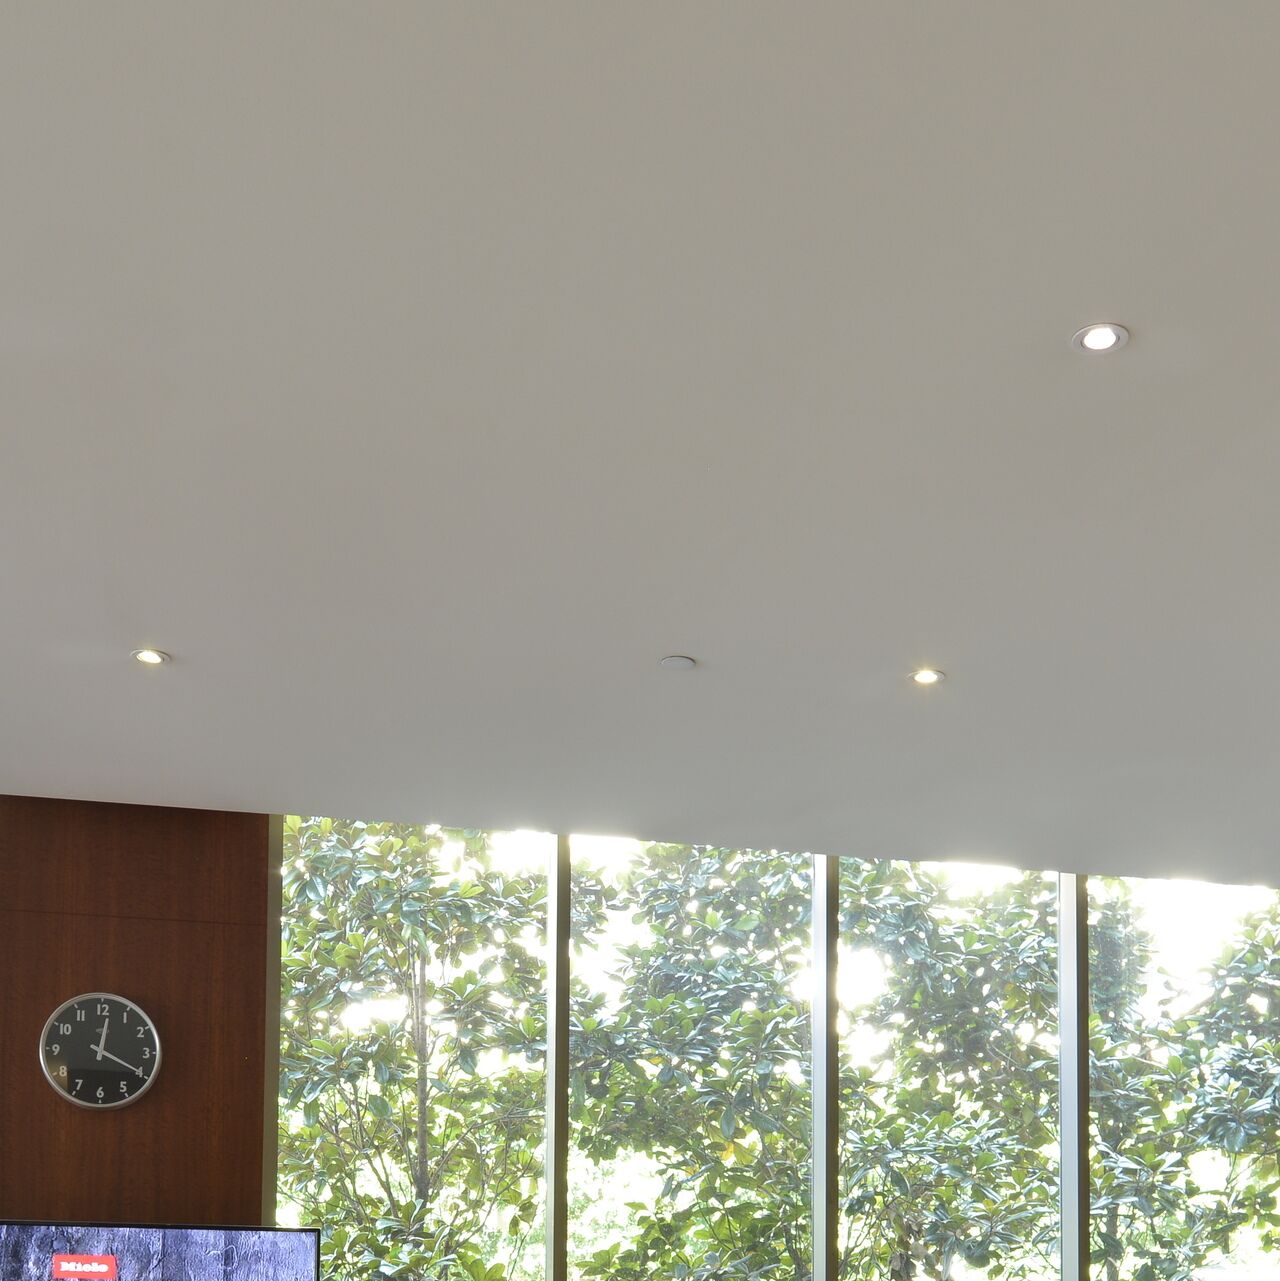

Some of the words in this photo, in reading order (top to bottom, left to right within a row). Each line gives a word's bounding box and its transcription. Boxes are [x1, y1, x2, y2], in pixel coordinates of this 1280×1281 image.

[76, 1010, 86, 1022] 11
[96, 1004, 110, 1016] 12
[122, 1012, 128, 1024] 1
[59, 1023, 72, 1035] 10
[136, 1026, 145, 1038] 2
[51, 1044, 61, 1056] 9
[142, 1048, 150, 1059] 3
[58, 1065, 67, 1077] 8
[135, 1066, 144, 1078] 4
[75, 1079, 84, 1091] 7
[119, 1081, 127, 1093] 5
[95, 1086, 105, 1098] 6
[60, 1261, 109, 1272] Miele
